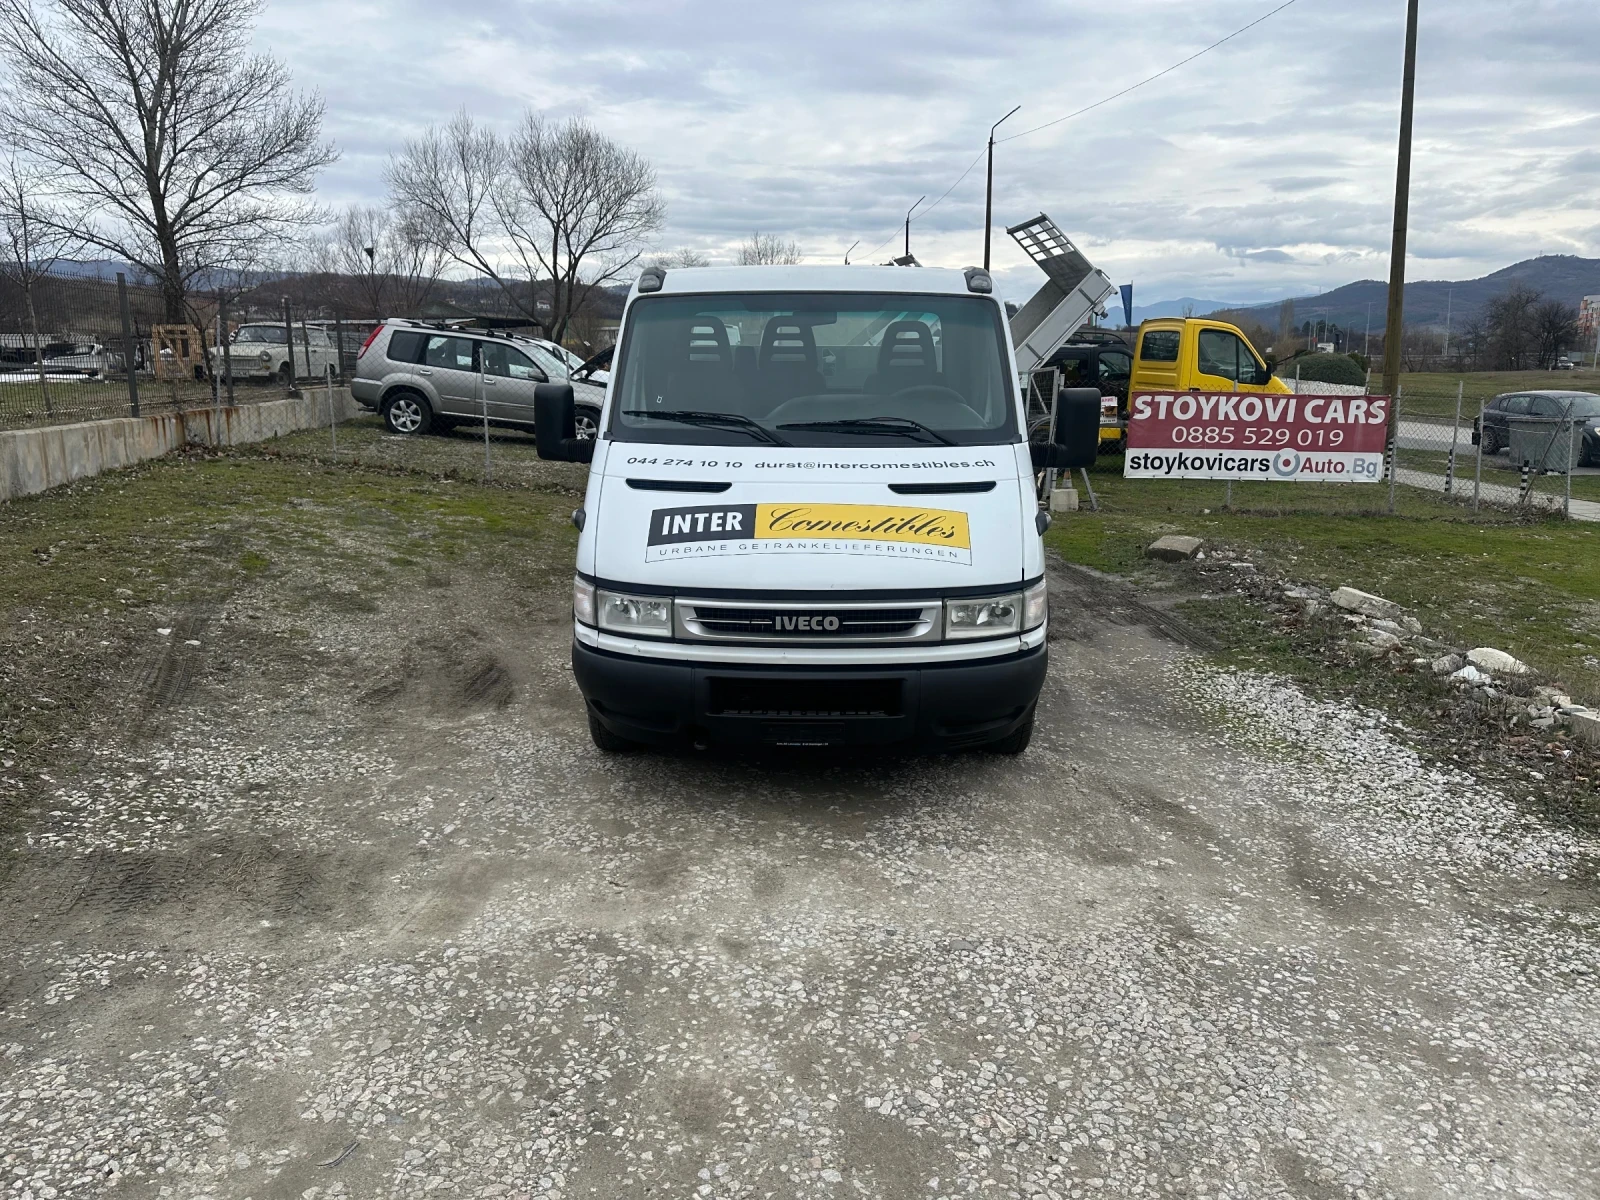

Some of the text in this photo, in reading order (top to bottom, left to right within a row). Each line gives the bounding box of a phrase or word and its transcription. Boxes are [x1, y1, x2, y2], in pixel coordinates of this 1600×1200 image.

[1133, 395, 1387, 425] STOYKOVI CARS
[1171, 426, 1344, 446] 0885 529 019
[627, 457, 995, 470] 044 274 10 10 durst@intercomestibles.ch
[1129, 452, 1378, 478] stoykovicars Auto.Bg
[661, 511, 743, 536] INTER
[769, 507, 956, 539] Comestibles
[659, 544, 728, 556] URBANE
[775, 616, 839, 630] IVECO
